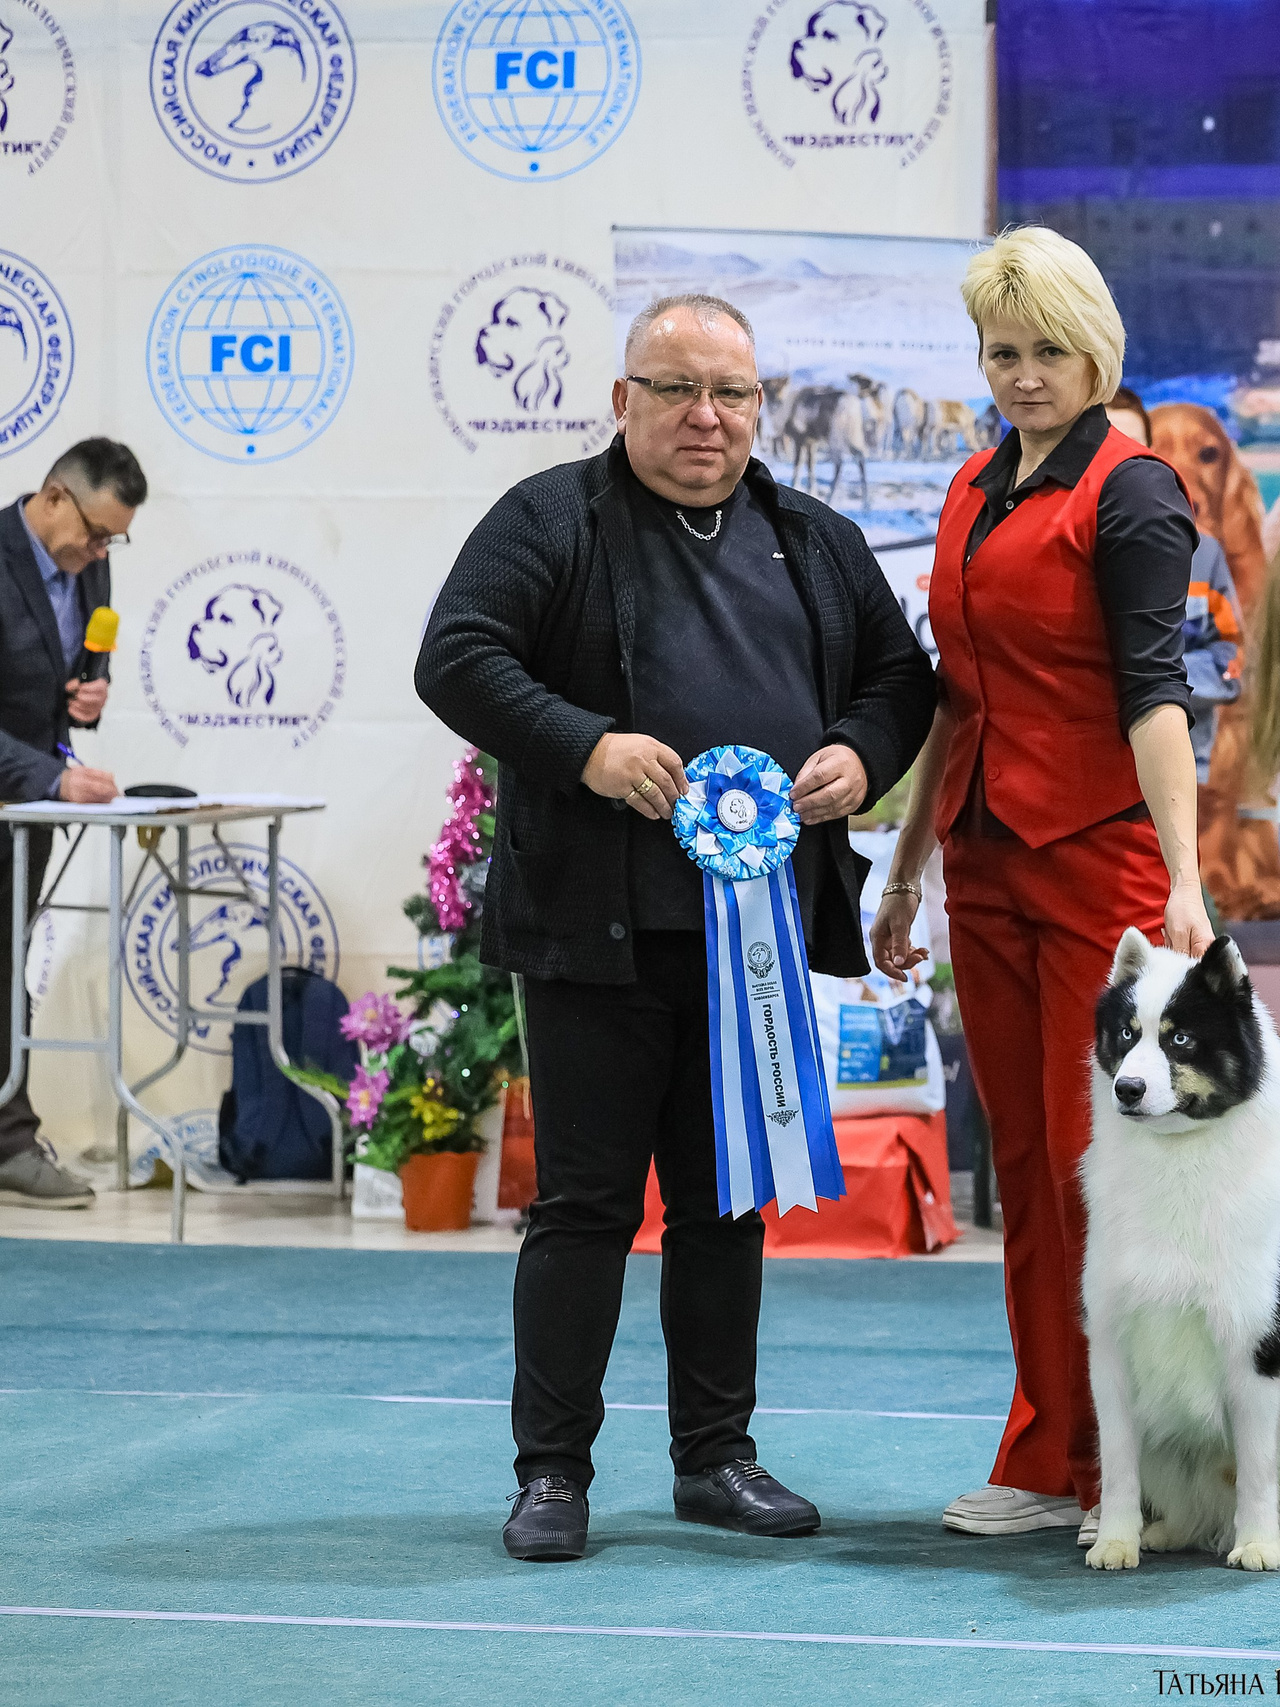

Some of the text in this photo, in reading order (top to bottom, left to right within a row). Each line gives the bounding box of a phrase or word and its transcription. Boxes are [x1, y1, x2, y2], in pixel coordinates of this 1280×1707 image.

[162, 39, 232, 167] РОССИЙСКАЯ
[273, 54, 345, 167] ФЕДЕРАЦИЯ
[442, 22, 478, 144] FEDERATION
[496, 50, 575, 90] FCI
[175, 253, 302, 304] CYNOLOGIQUE
[157, 304, 194, 425] FEDERATION
[211, 334, 291, 373] FCI
[303, 278, 346, 431] INTERNATIONALE
[762, 1003, 786, 1108] ГОРДОСТЬ РОССИИ
